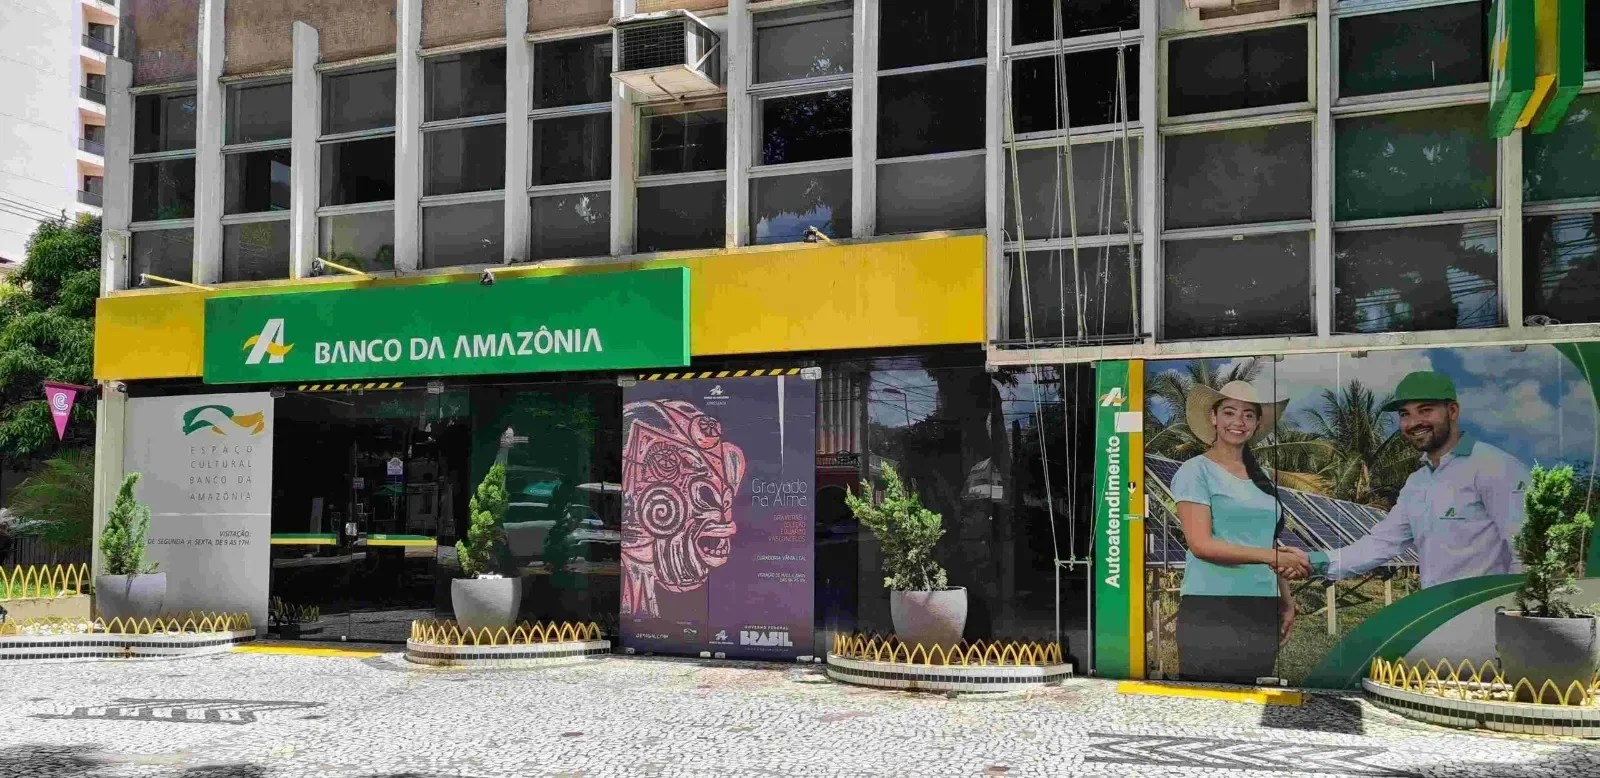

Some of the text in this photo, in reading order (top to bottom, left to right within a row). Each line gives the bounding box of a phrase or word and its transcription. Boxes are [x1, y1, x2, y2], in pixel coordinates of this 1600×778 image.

[315, 325, 603, 364] BANCO DA AMAZÔNIA
[190, 445, 253, 456] ESPAÇO
[190, 459, 252, 468] CULTURAL
[189, 475, 252, 484] BANCO DA
[751, 478, 808, 495] Gravado
[190, 490, 252, 501] AMAZÔNIA
[751, 492, 808, 507] na Alma
[1105, 435, 1121, 588] Autoatendimento
[740, 630, 793, 647] BRASIL
